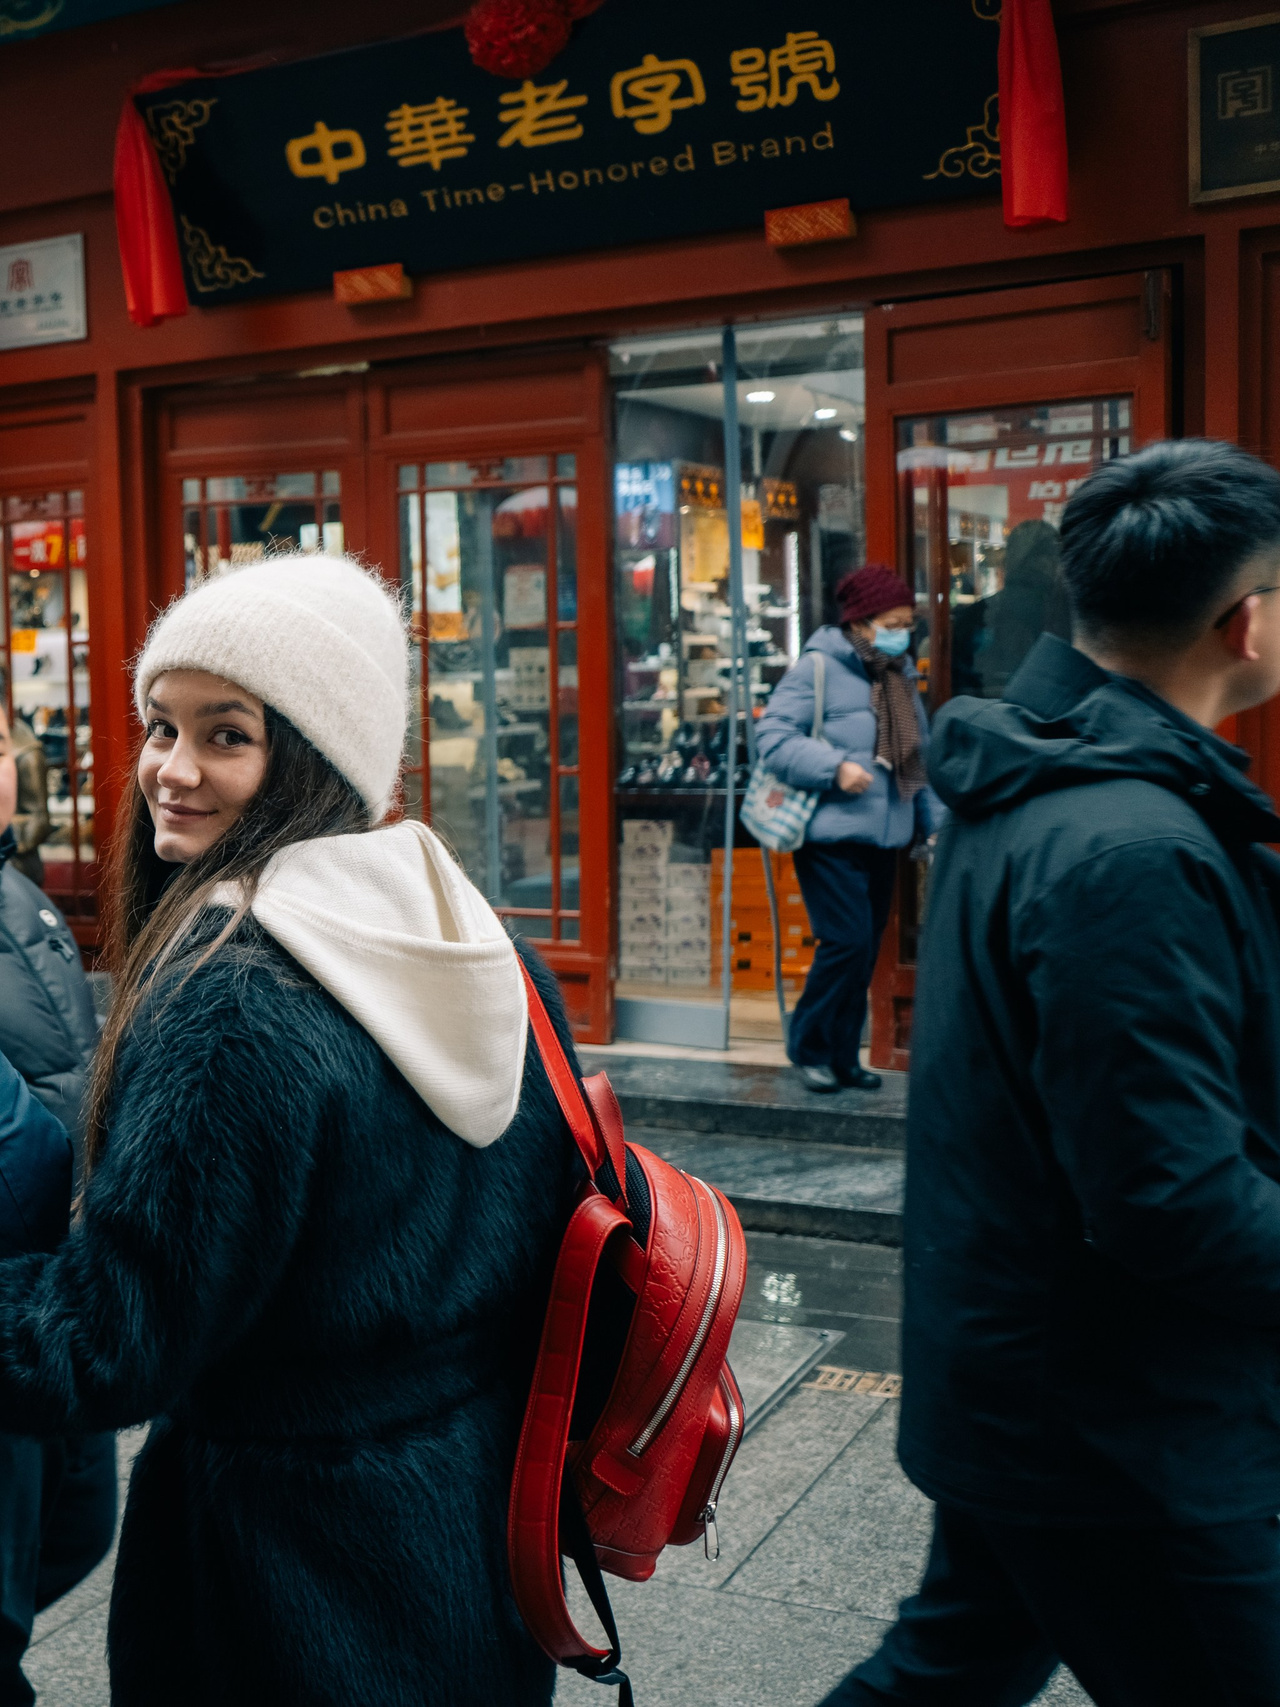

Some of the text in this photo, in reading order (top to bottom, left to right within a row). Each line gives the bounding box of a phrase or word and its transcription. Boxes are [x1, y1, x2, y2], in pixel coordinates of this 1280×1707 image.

[285, 31, 840, 185] 中華老字號
[313, 121, 835, 229] China Time-Honored Brand
